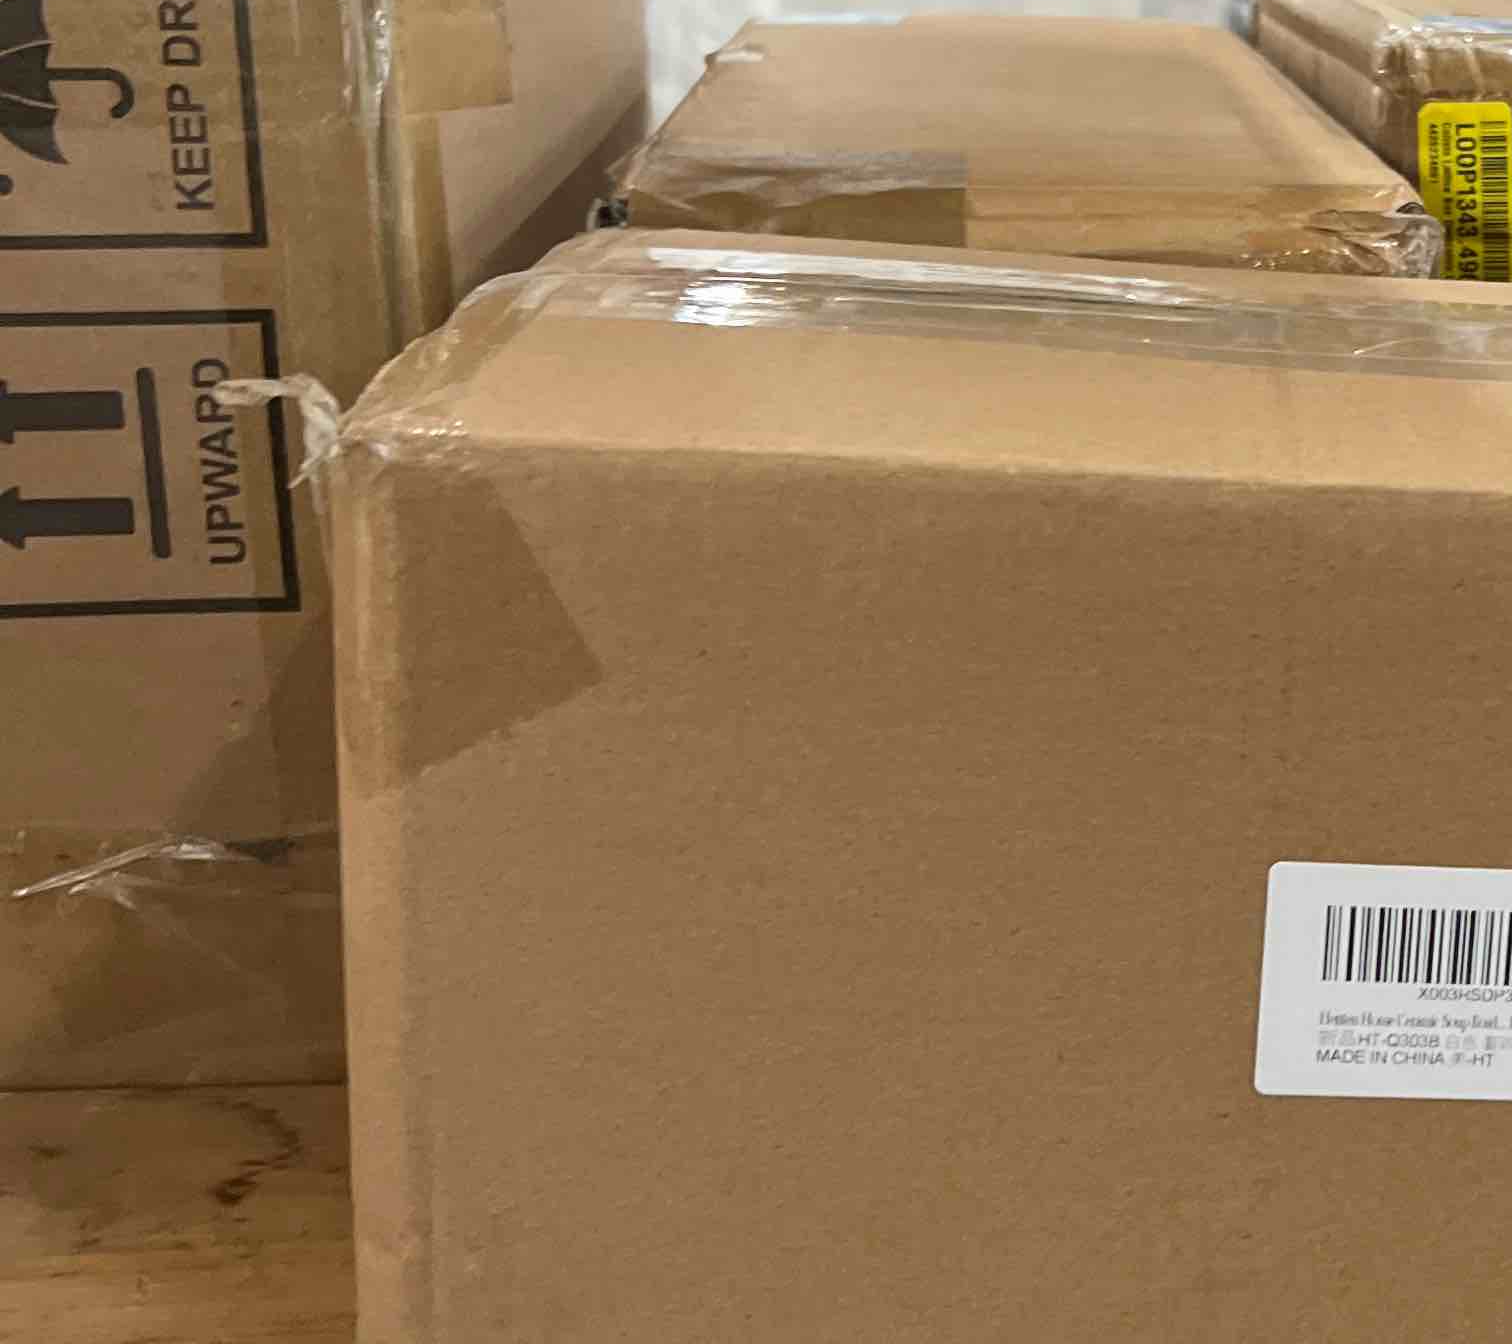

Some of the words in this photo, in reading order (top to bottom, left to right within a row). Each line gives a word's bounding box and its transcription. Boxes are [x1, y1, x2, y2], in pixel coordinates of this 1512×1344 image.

[168, 83, 215, 212] KEEP
[191, 357, 248, 567] UPWARD
[1316, 1049, 1365, 1064] MADE
[1370, 1050, 1388, 1064] IN
[1392, 1051, 1445, 1065] CHINA
